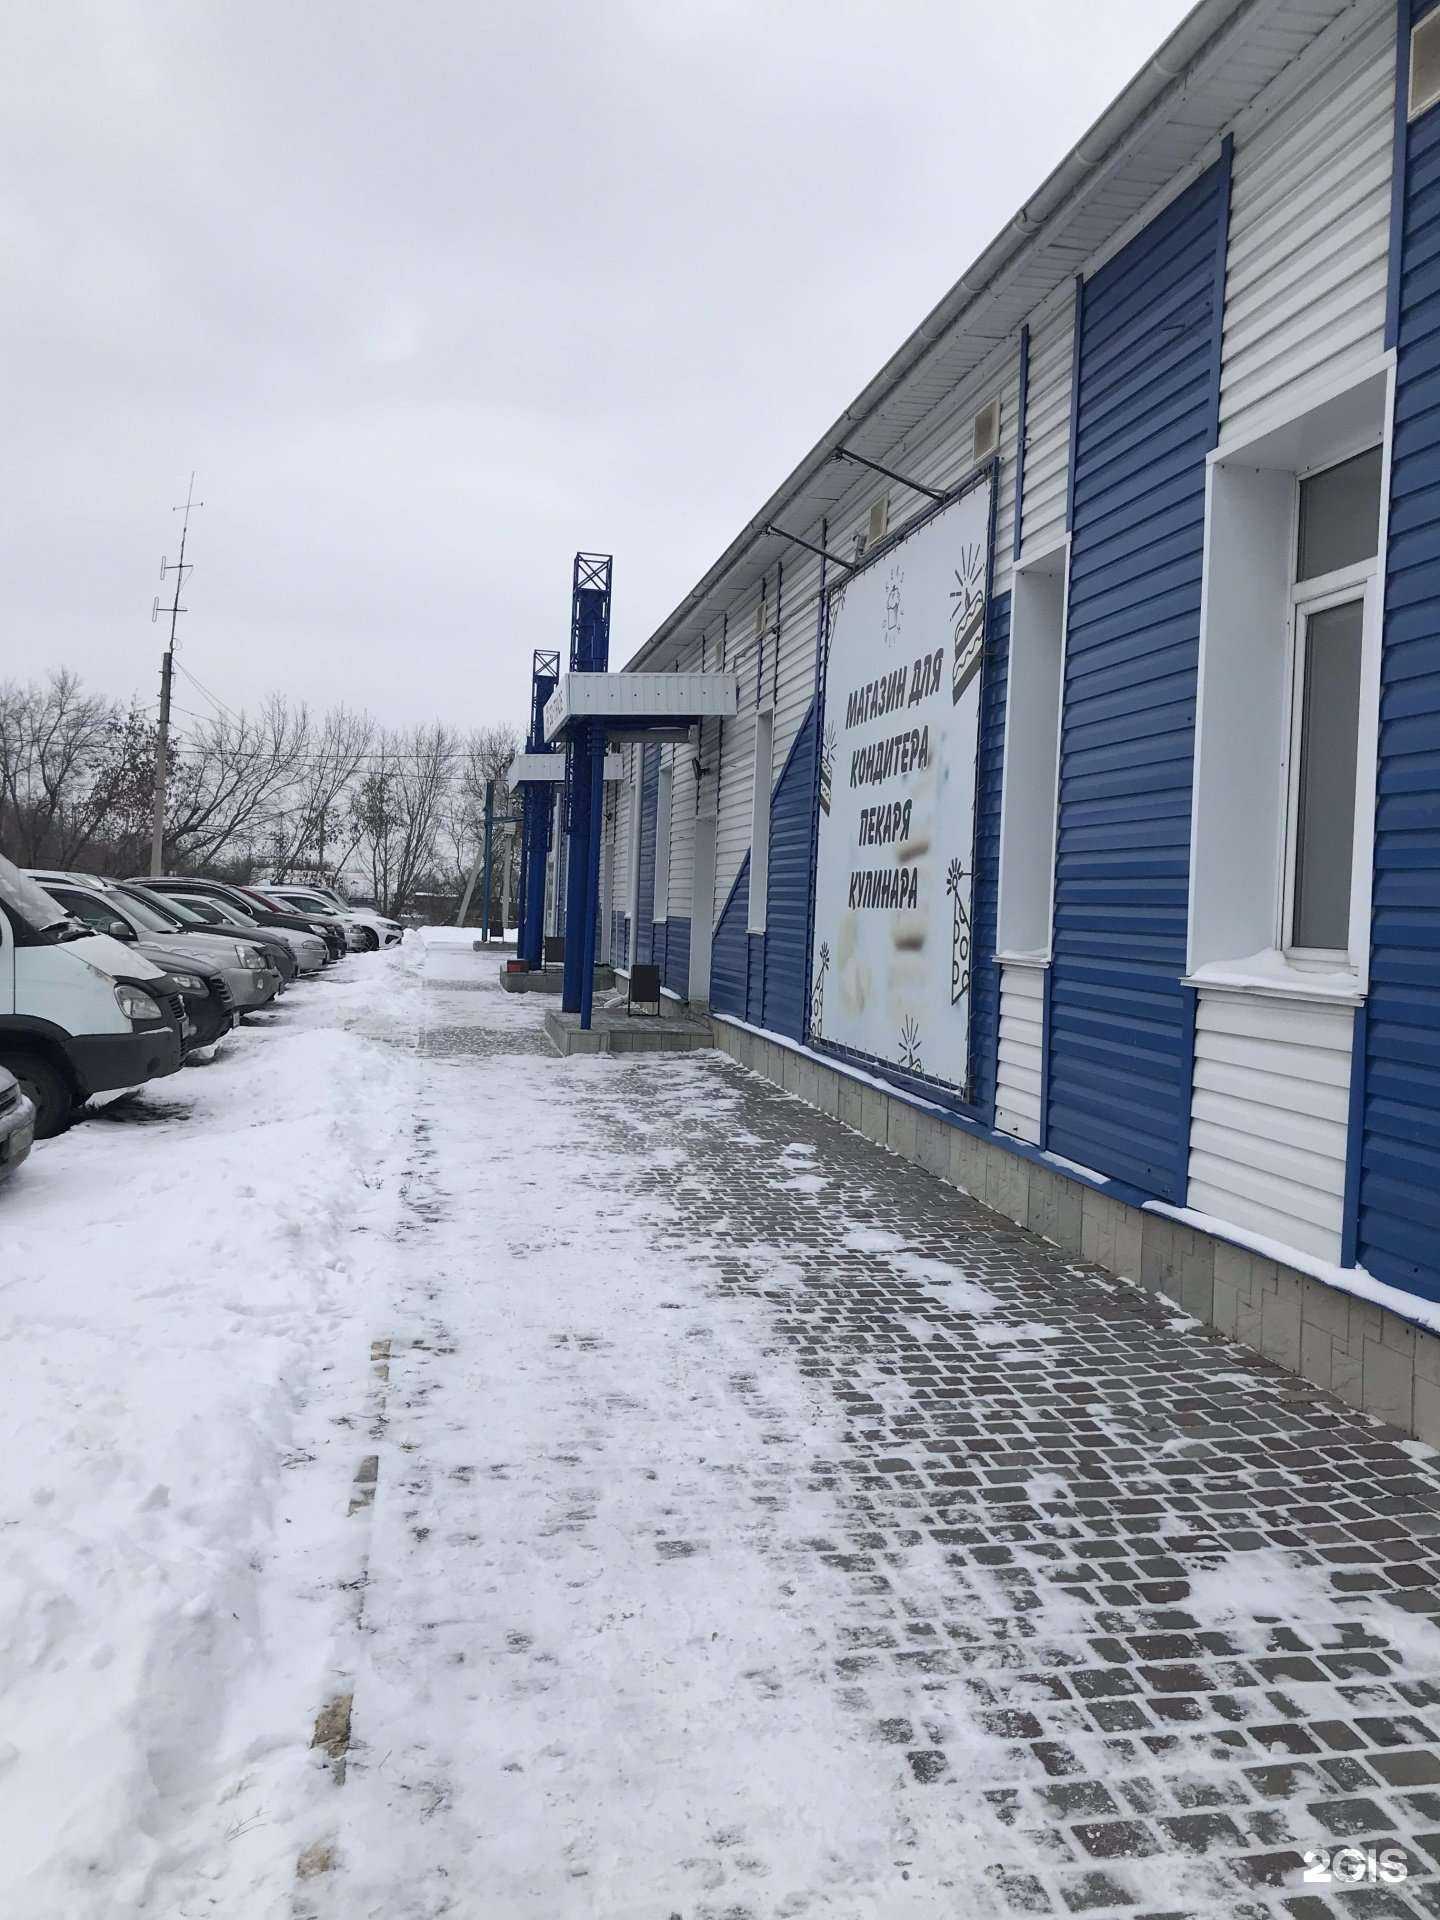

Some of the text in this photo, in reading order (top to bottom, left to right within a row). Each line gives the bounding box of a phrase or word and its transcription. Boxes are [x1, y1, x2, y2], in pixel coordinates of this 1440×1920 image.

[845, 647, 944, 730] МАГАЗИН ДЛЯ
[849, 724, 929, 789] КОНДИТЕРА
[858, 798, 913, 847] ПЕКАРЯ
[848, 866, 918, 910] КУЛИНАРА
